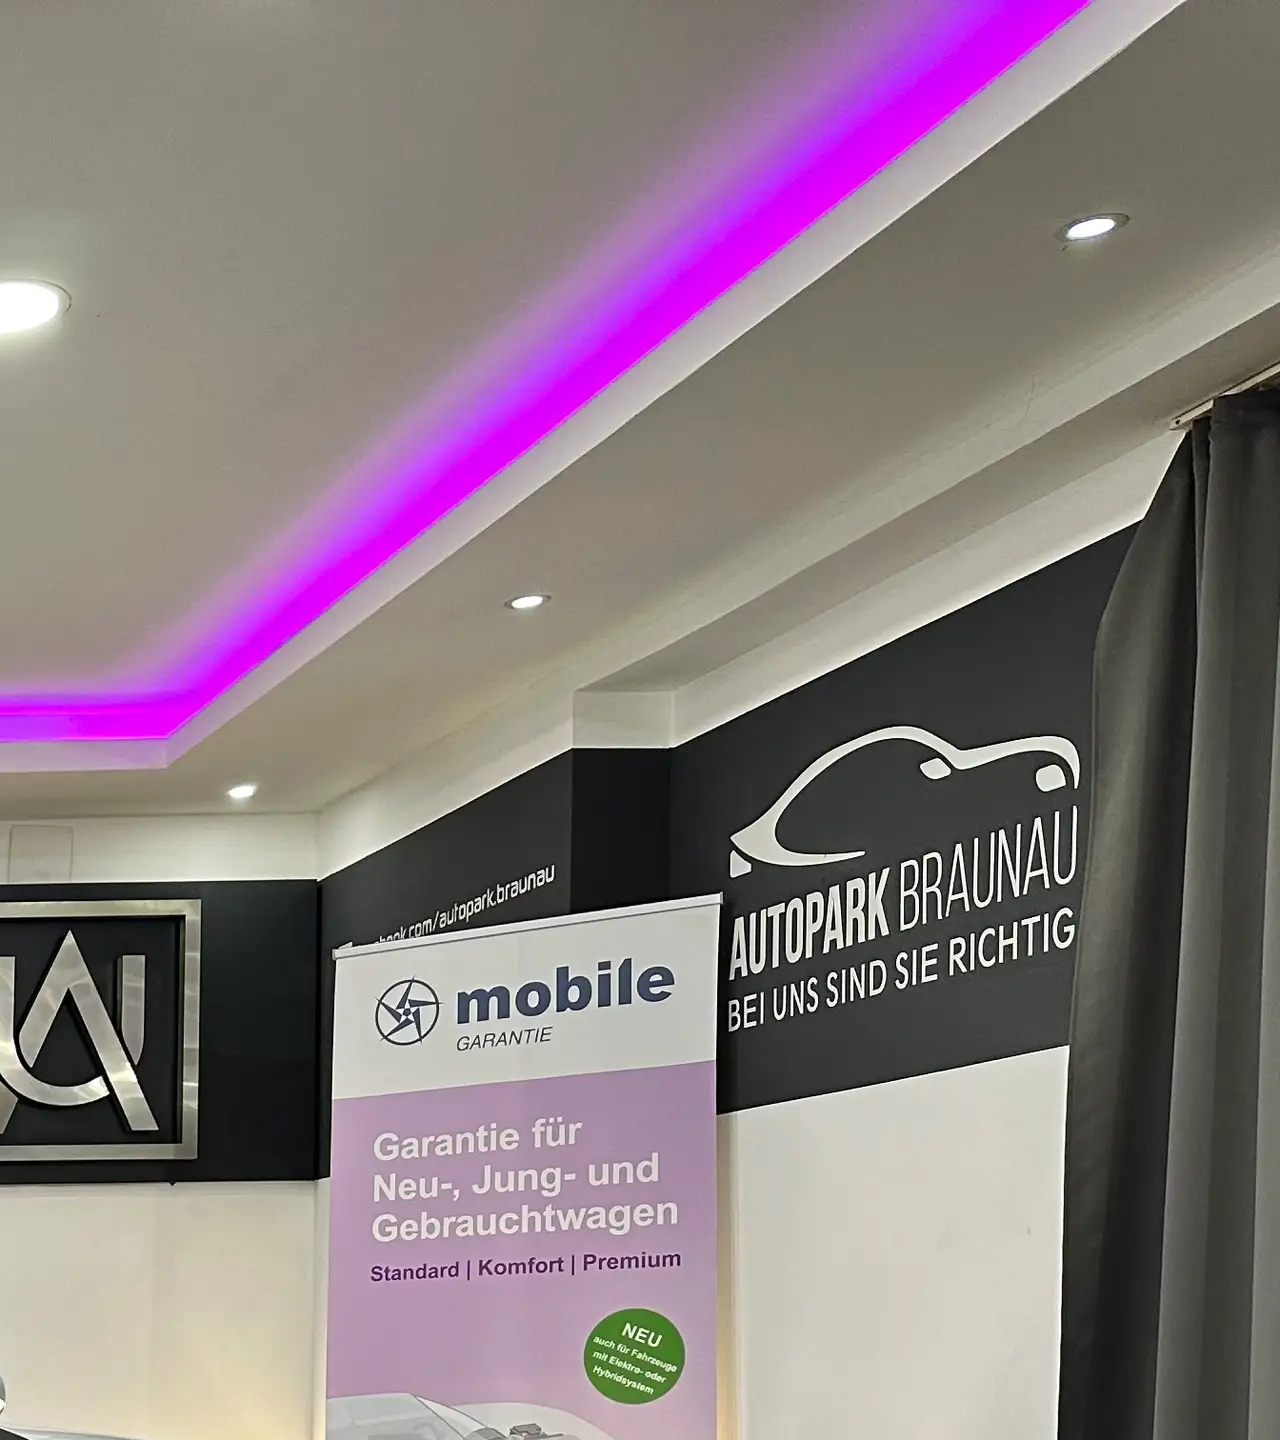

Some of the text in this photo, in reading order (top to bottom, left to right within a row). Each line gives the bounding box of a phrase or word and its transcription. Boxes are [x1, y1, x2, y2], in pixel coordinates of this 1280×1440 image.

[729, 806, 1077, 980] AUTOPARK BRAUNAU
[729, 908, 1075, 1031] BEI UNS SIND SIE RICHTIG
[457, 958, 675, 1025] mobile
[456, 1026, 552, 1052] GARANTIE
[373, 1116, 582, 1161] Garantie für
[373, 1152, 659, 1202] Neu-, Jung- und
[372, 1201, 678, 1243] Gebrauchtwagen
[370, 1260, 460, 1282] Standard
[478, 1256, 565, 1276] Komfort
[583, 1251, 681, 1271] Premium
[593, 1336, 616, 1350] auch
[616, 1343, 631, 1355] für
[621, 1322, 663, 1348] NEU
[592, 1350, 609, 1362] mit
[644, 1370, 667, 1384] oder
[592, 1364, 655, 1395] Hybridsystem
